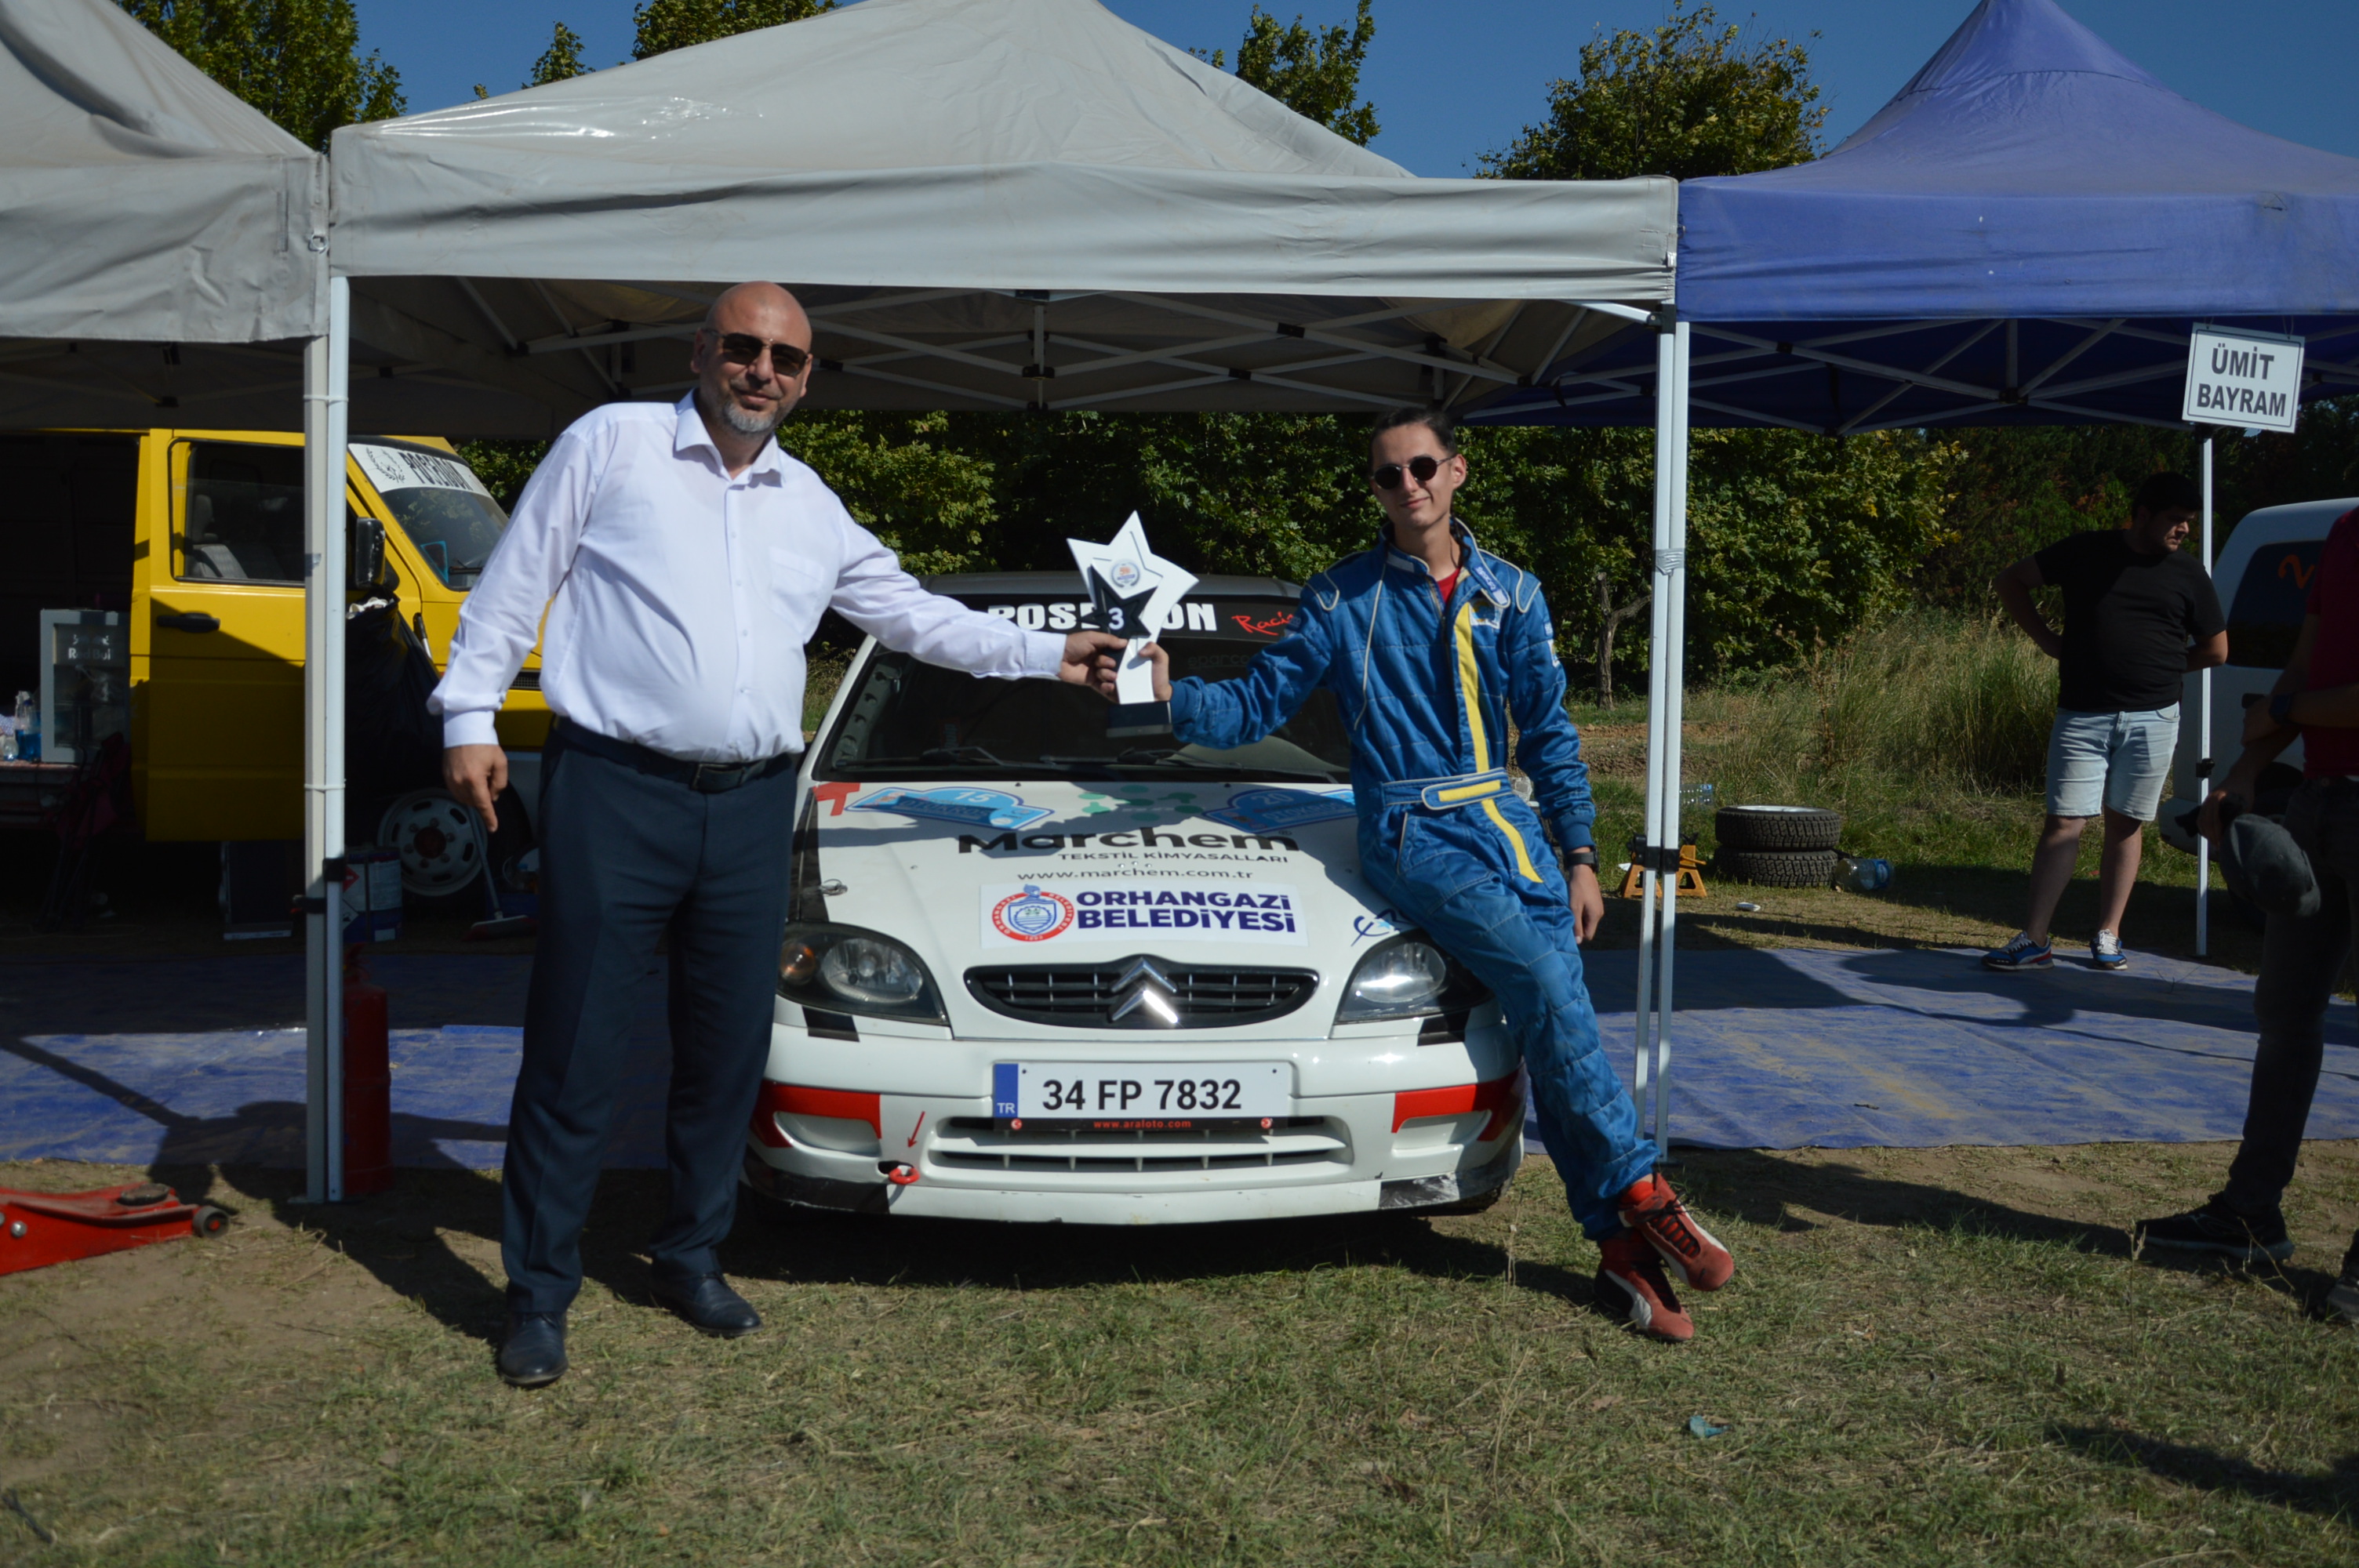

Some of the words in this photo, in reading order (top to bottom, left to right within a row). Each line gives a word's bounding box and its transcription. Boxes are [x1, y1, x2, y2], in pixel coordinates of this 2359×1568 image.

[2212, 343, 2274, 380] ÜMİT
[2197, 383, 2286, 417] BAYRAM
[1108, 607, 1125, 630] 3
[955, 790, 997, 803] 15
[1251, 793, 1294, 805] 20
[958, 826, 1299, 854] Marchem
[1058, 851, 1138, 861] TEKSTİL
[1143, 851, 1289, 863] KİMYASALLARI
[1017, 868, 1253, 880] www.marchem.com.tr
[1077, 891, 1291, 910] ORHANGAZİ
[1077, 909, 1296, 933] BELEDİYESİ
[1042, 1079, 1085, 1111] 34
[1099, 1080, 1143, 1111] FP
[1154, 1079, 1241, 1110] 7832
[997, 1102, 1016, 1114] TR
[1093, 1119, 1191, 1129] www.araloto.com
